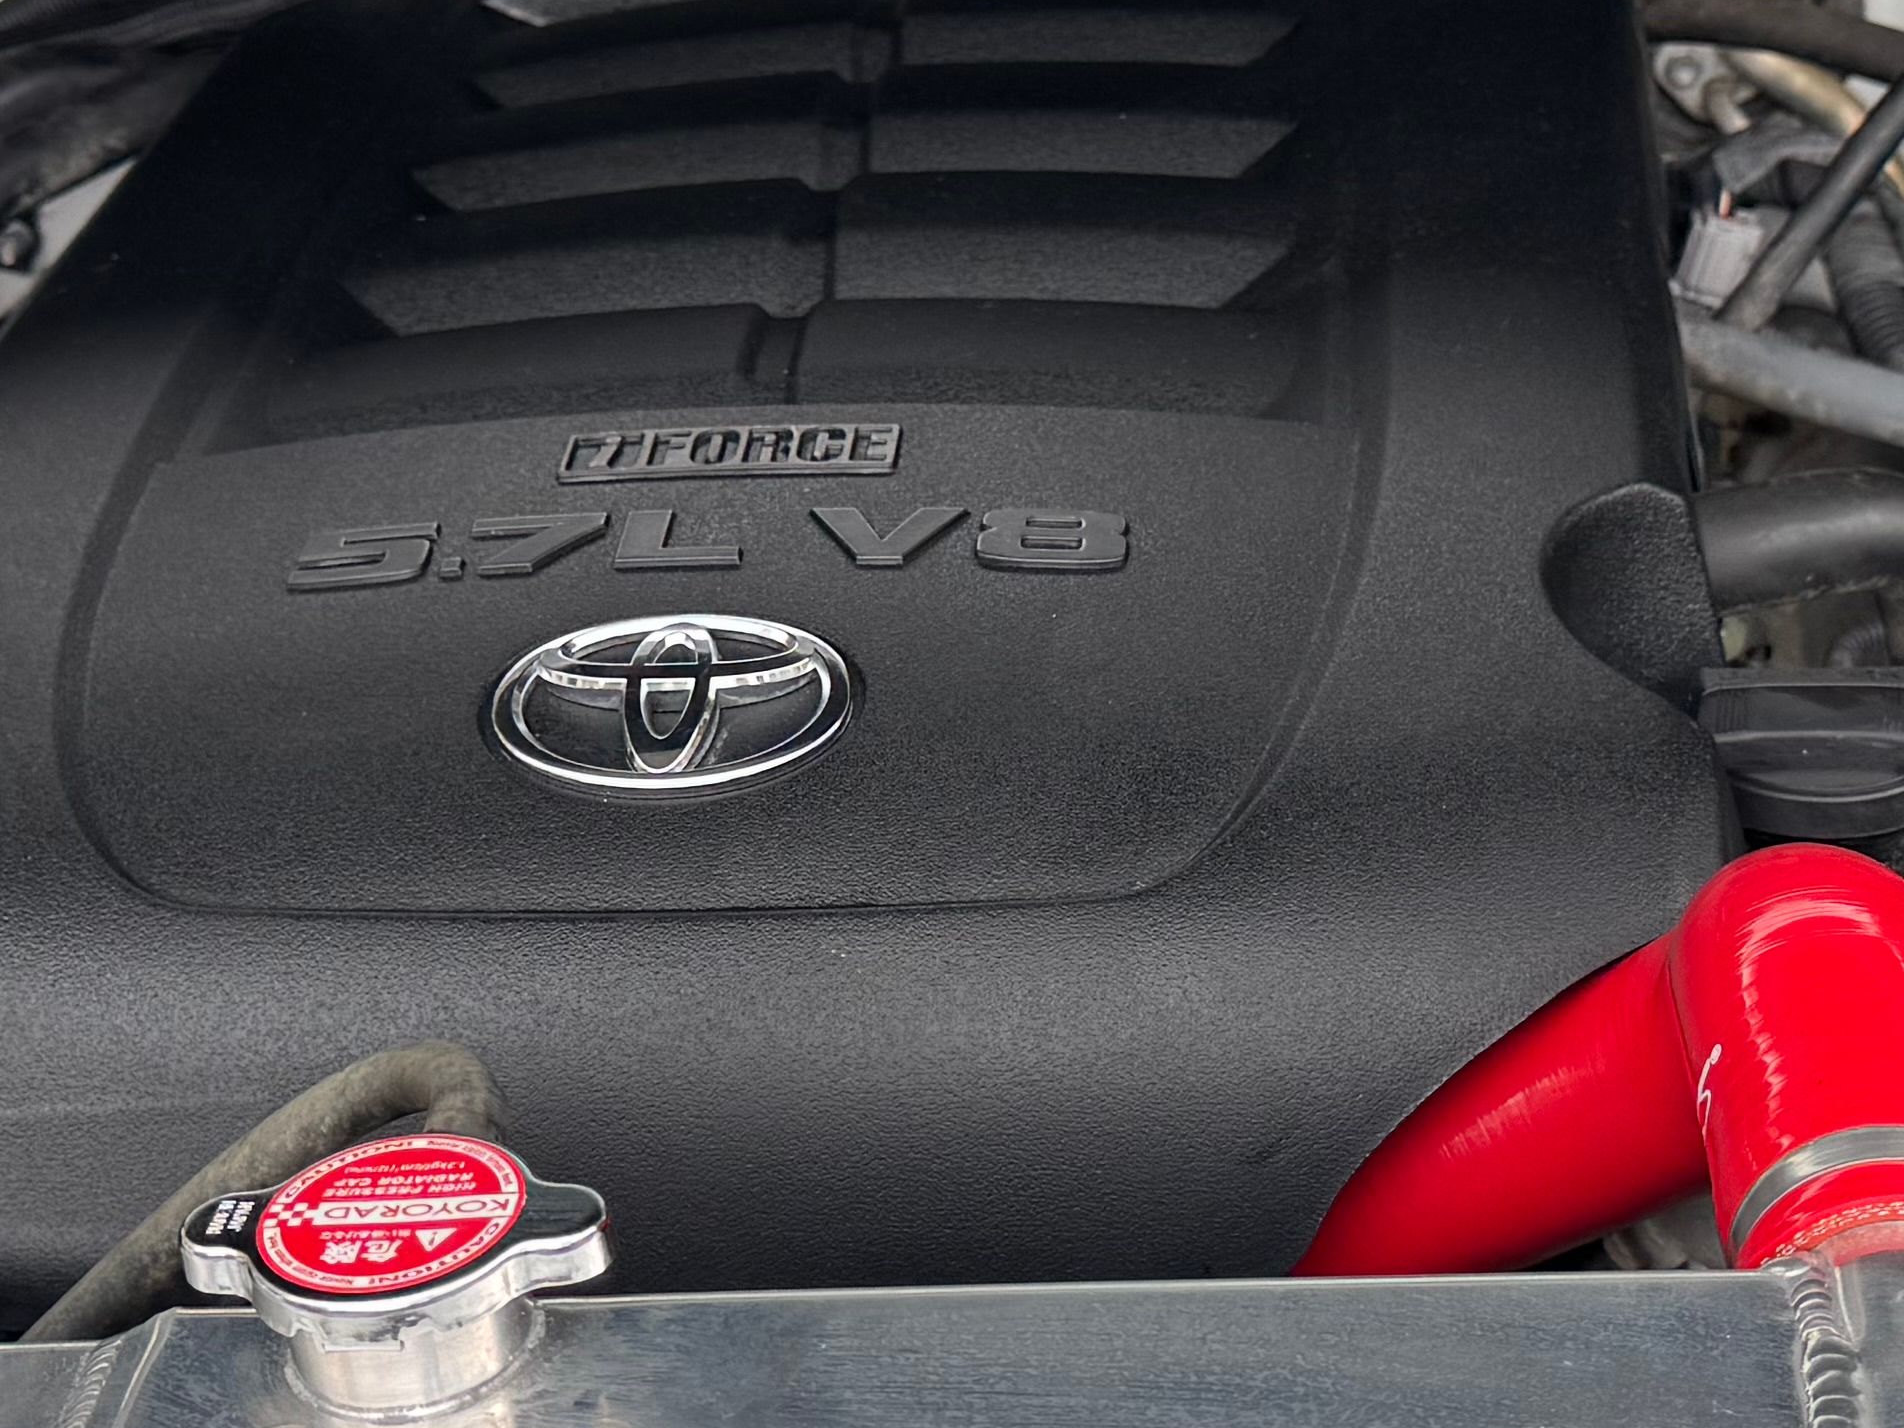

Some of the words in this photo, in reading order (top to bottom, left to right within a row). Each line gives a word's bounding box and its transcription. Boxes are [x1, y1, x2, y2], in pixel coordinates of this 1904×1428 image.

[287, 509, 743, 593] 5.7L
[808, 505, 1131, 573] V8
[334, 1177, 373, 1187] CAP
[376, 1172, 475, 1185] RADIATOR
[323, 1185, 425, 1197] PRESSURE
[429, 1181, 477, 1193] HIGH
[323, 1198, 511, 1220] KOYORAD
[318, 1239, 404, 1265] 危険
